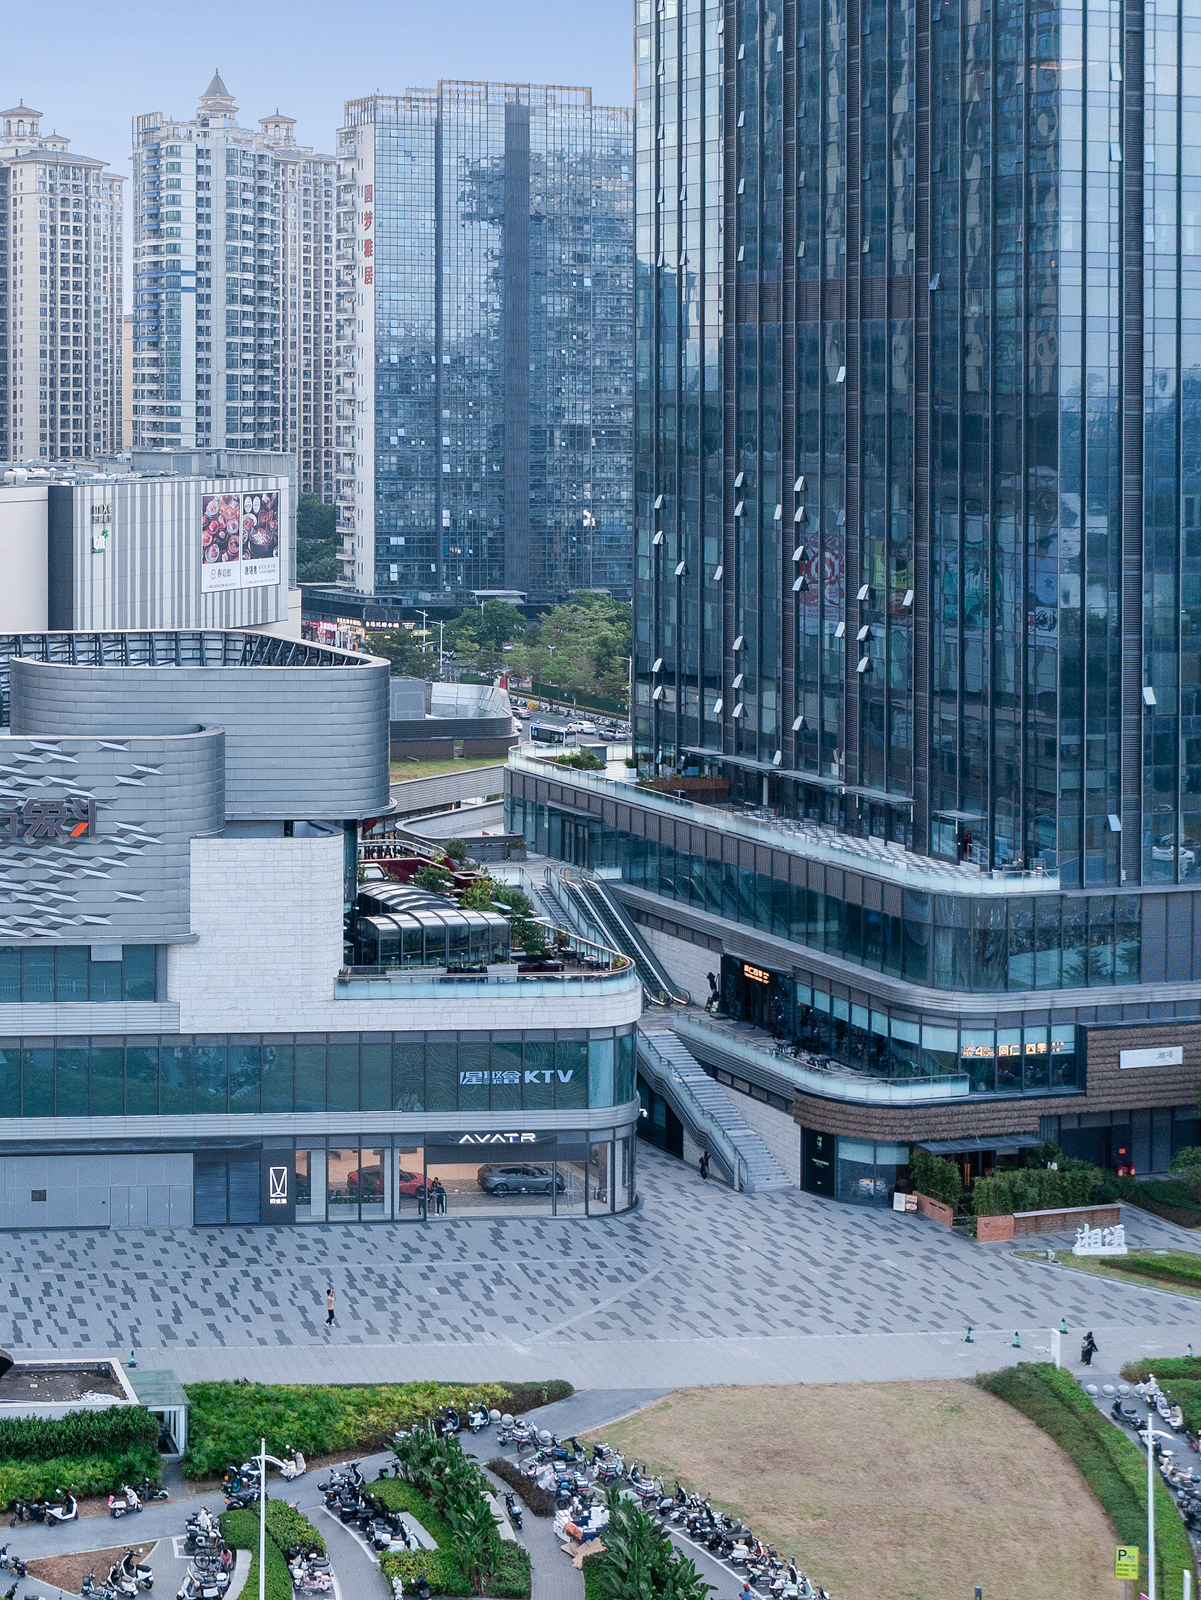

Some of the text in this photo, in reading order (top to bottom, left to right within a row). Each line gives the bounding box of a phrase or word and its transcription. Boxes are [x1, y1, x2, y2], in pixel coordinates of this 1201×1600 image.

[998, 1045, 1020, 1056] 同仁
[1026, 1042, 1047, 1054] 四季
[459, 1132, 536, 1144] AVATR
[1118, 1549, 1127, 1561] P
